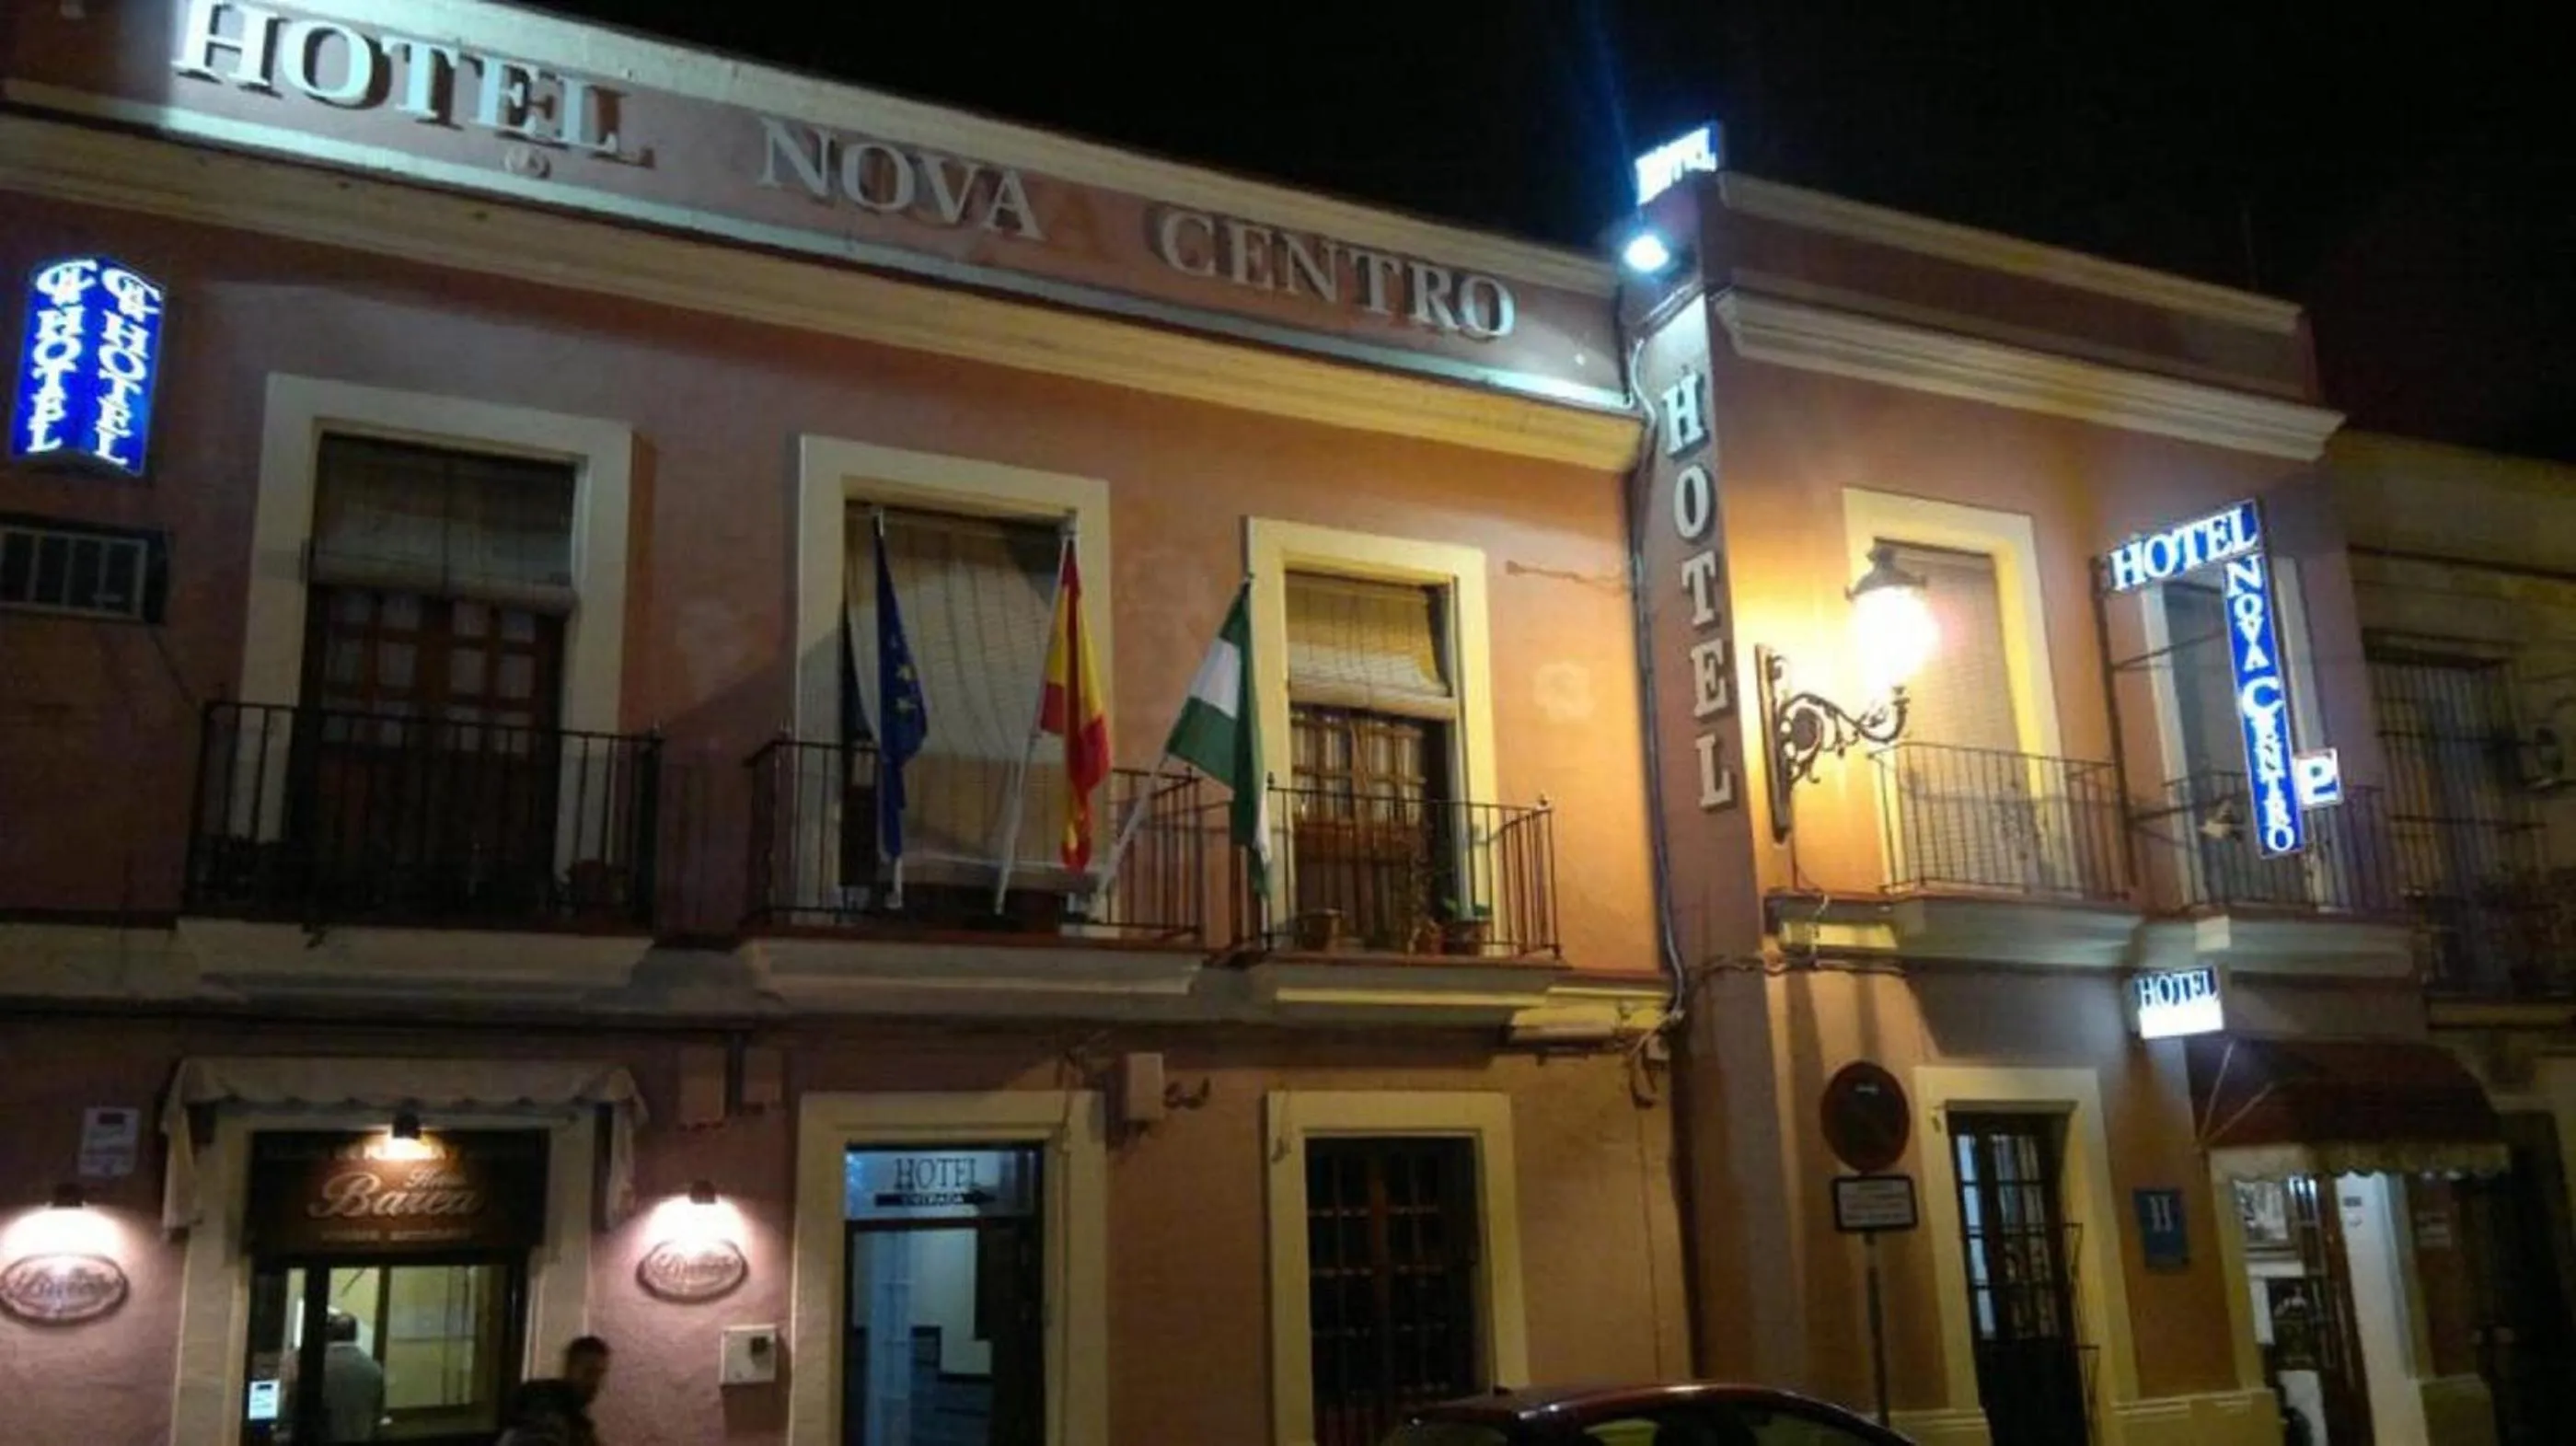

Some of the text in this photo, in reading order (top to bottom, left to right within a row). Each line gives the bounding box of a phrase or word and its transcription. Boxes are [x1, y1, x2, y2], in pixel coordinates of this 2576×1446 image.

[171, 0, 1517, 339] HOTEL NOVA CENTRO
[27, 305, 85, 453] HOTEL
[95, 309, 151, 466] HOTEL
[1660, 372, 1734, 810] HOTEL
[2108, 507, 2258, 592] HOTEL
[2224, 555, 2271, 672] NOVA
[2137, 970, 2219, 1010] HOTEL
